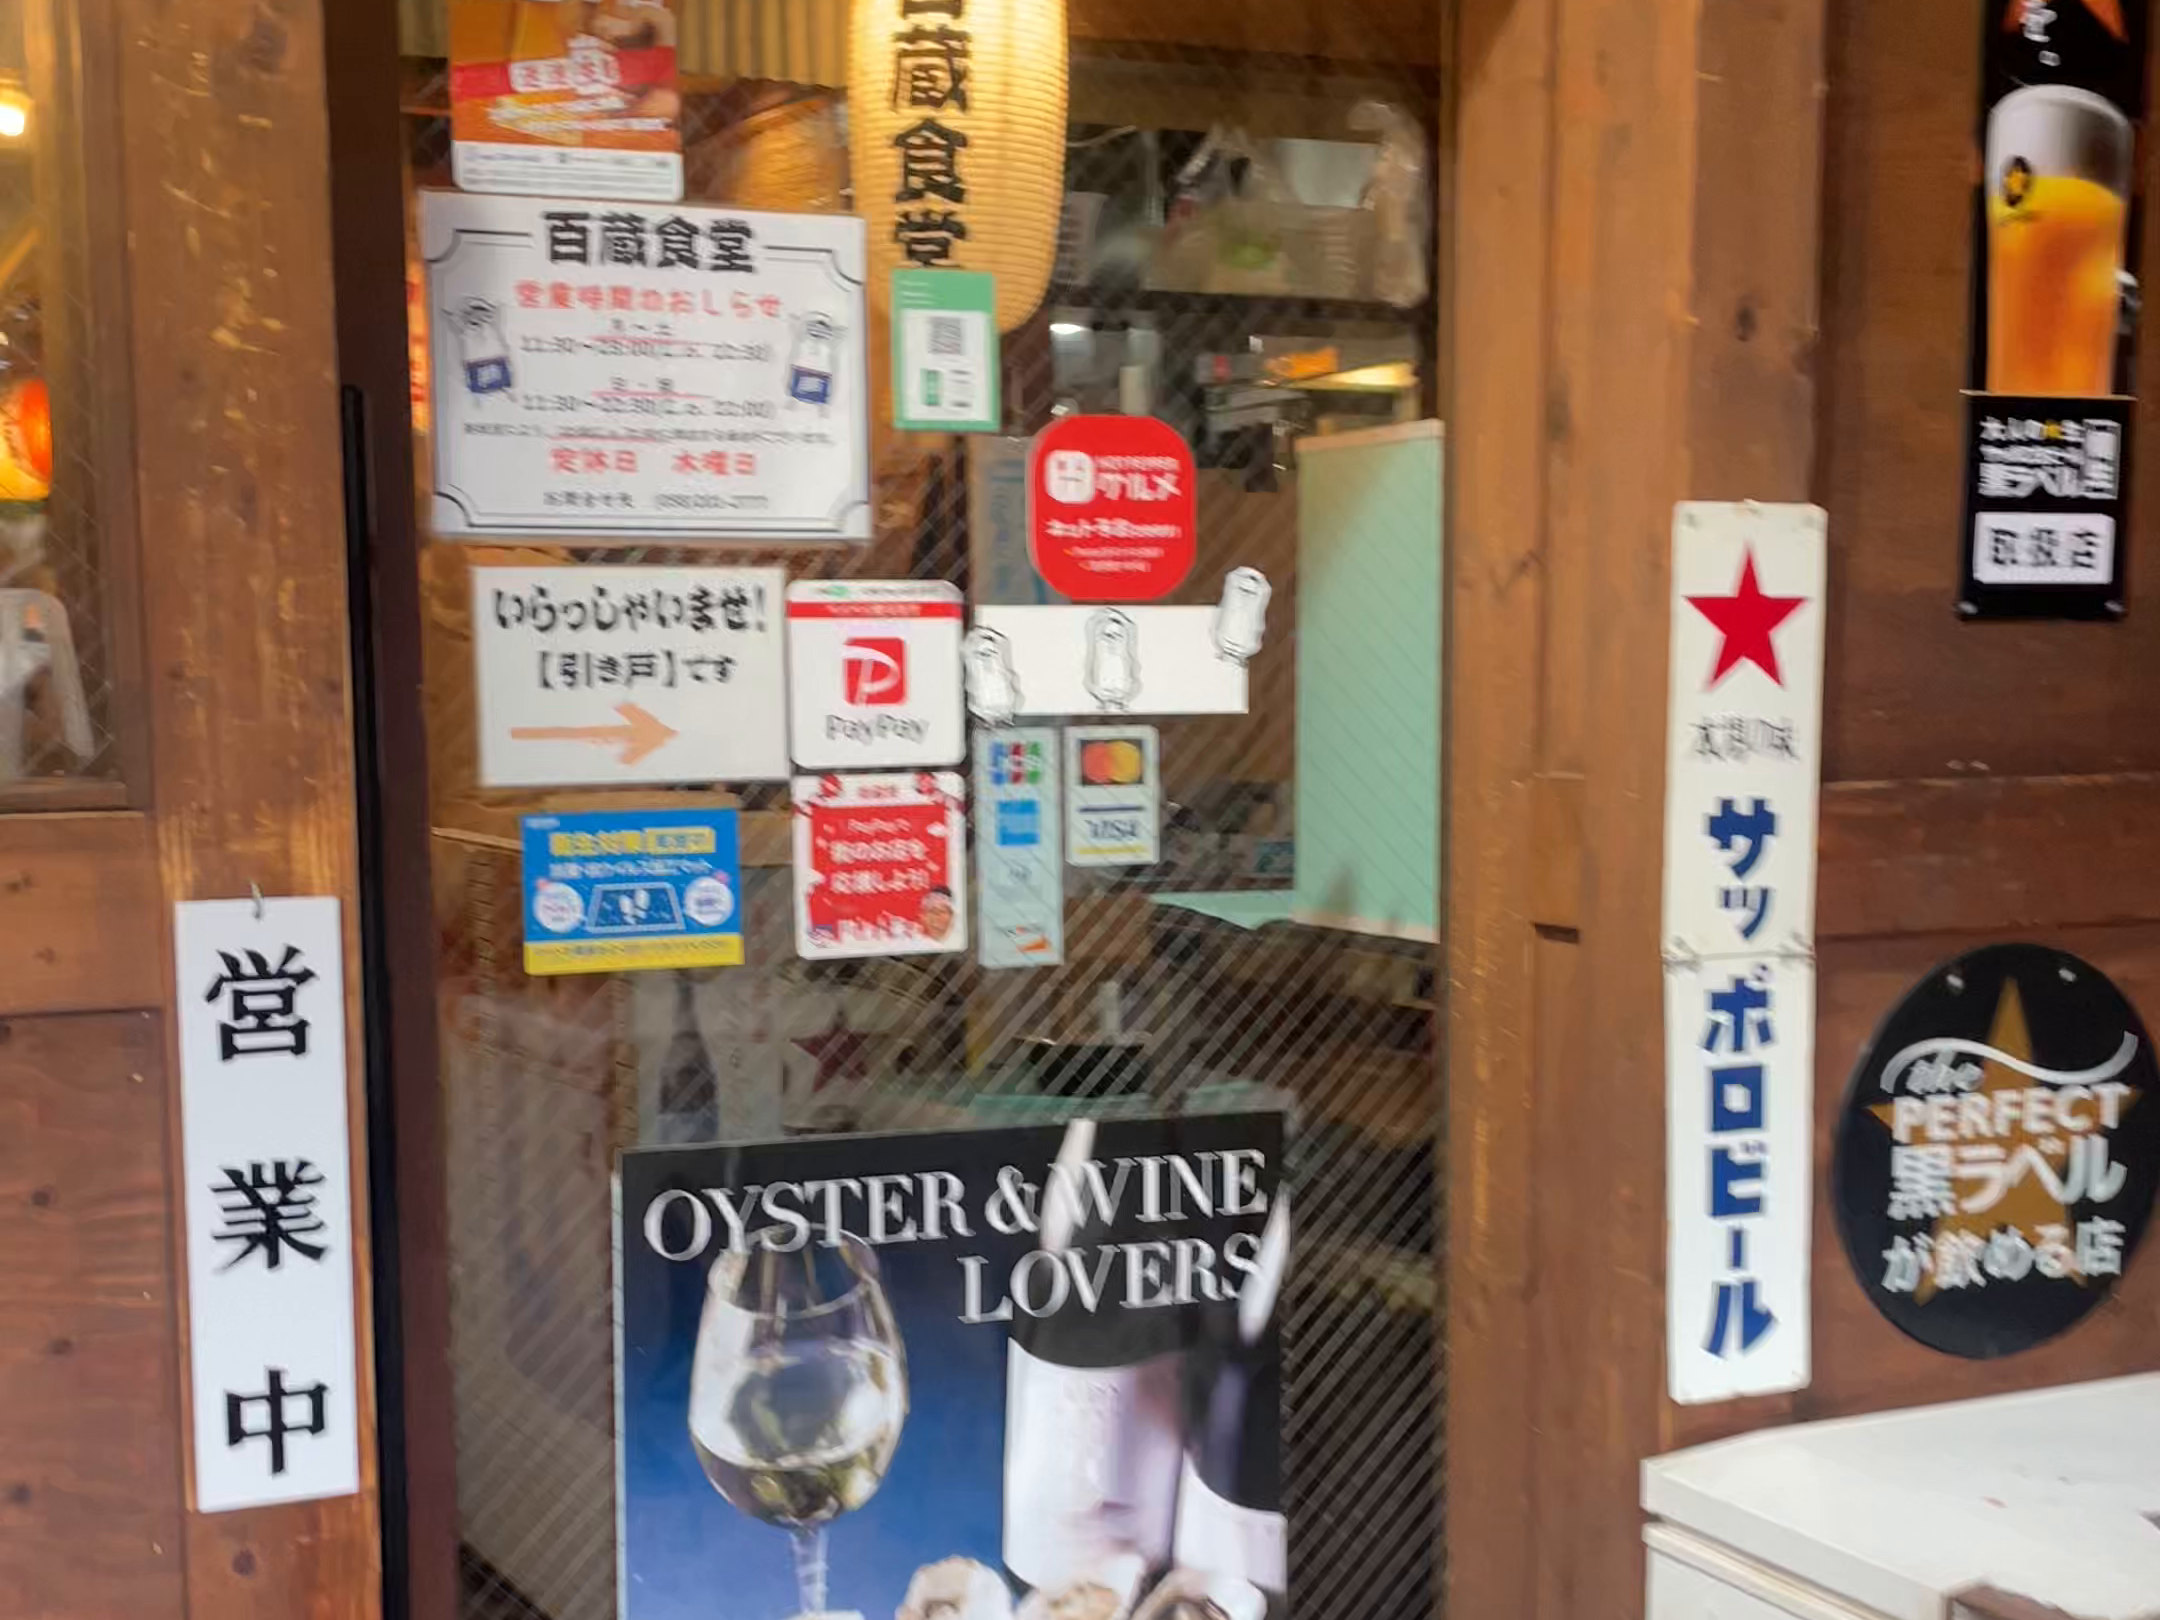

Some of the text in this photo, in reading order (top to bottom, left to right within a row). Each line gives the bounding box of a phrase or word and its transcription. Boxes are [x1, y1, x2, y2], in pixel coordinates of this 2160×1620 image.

[892, 0, 971, 267] 蔵食堂
[542, 211, 755, 273] 百蔵食堂
[549, 448, 639, 474] 定休日
[825, 714, 930, 745] PayPay
[1892, 1083, 2132, 1143] PERFECT
[204, 944, 331, 1476] 営業中
[643, 1148, 1269, 1262] OYSTER & WINE
[1887, 1134, 2128, 1220] 黒ラベル
[957, 1232, 1270, 1325] LOVERS
[1881, 1216, 2126, 1292] が飲める店
